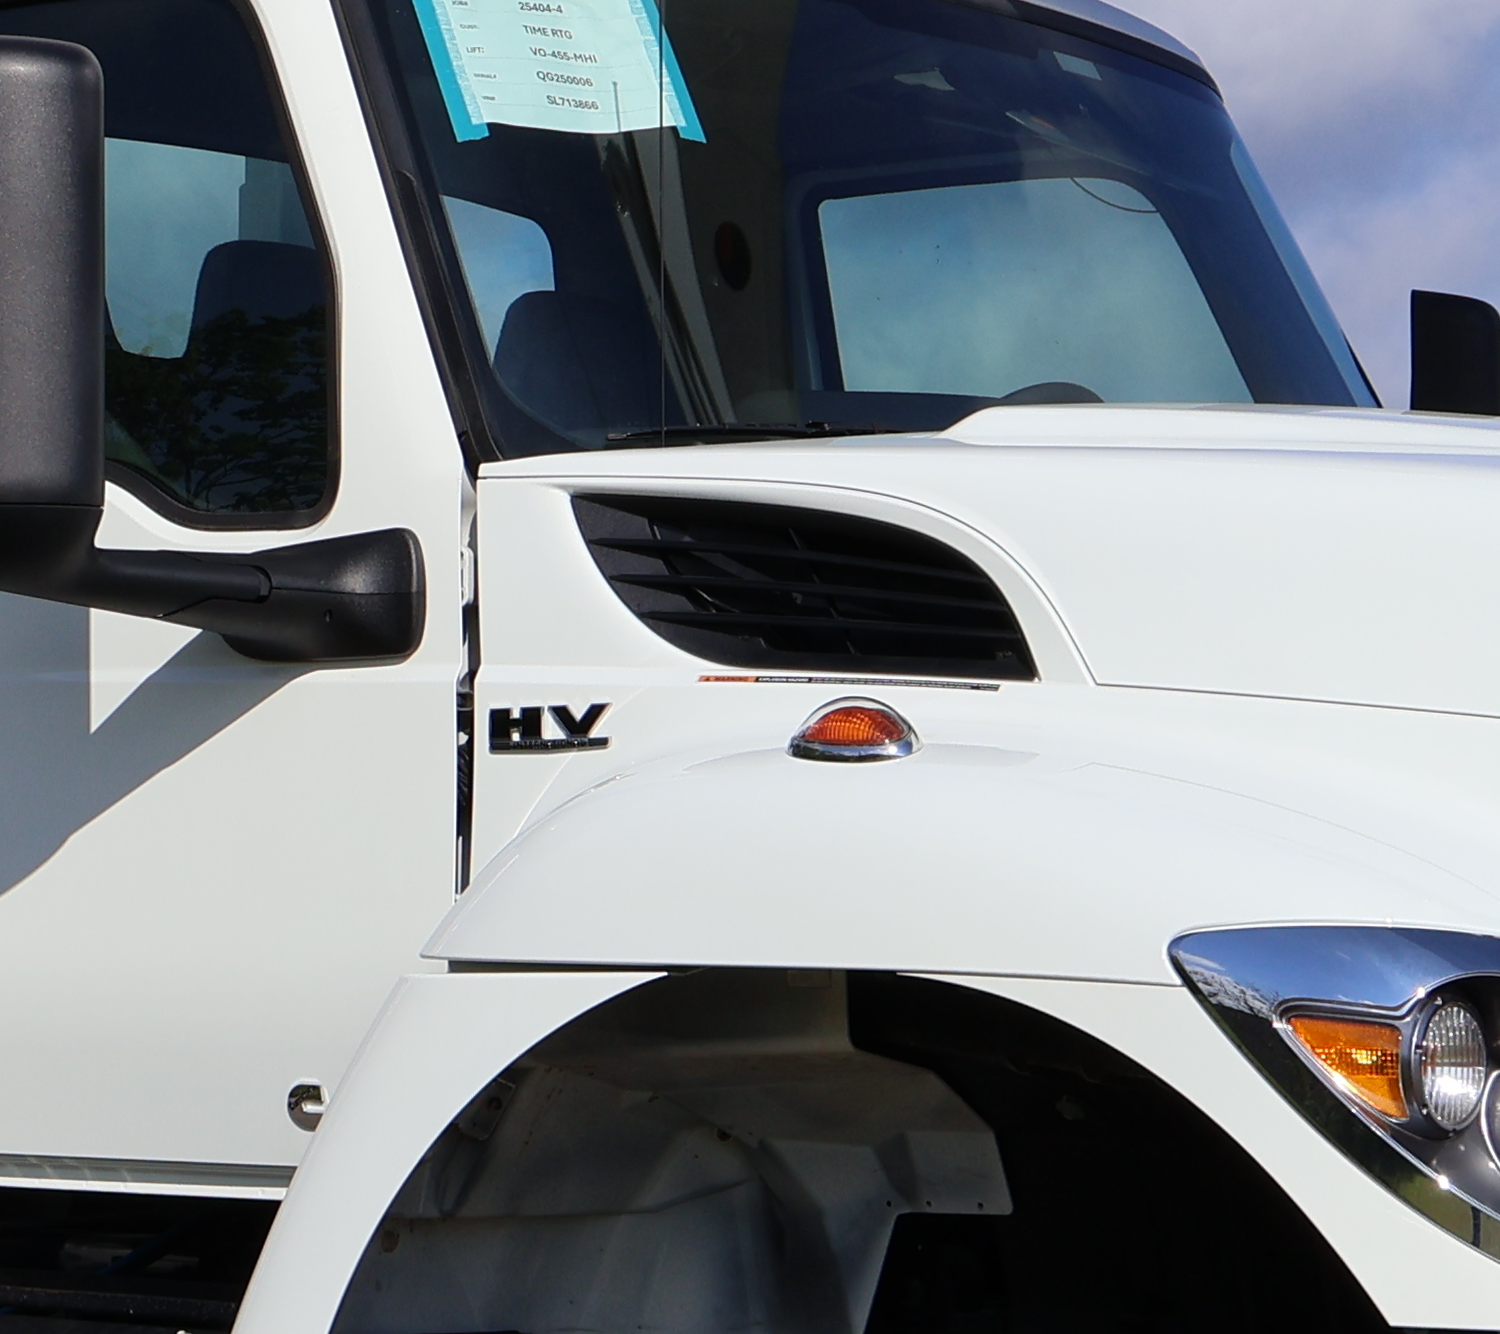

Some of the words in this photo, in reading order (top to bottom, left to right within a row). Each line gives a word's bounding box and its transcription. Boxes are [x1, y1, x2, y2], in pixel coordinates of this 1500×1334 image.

[518, 2, 563, 13] 25404-4
[522, 25, 549, 37] TIME
[551, 28, 573, 39] RTG
[530, 47, 597, 63] VO-455-MHI
[537, 71, 593, 86] QG250006
[546, 95, 599, 110] SL713866
[489, 703, 613, 741] HV
